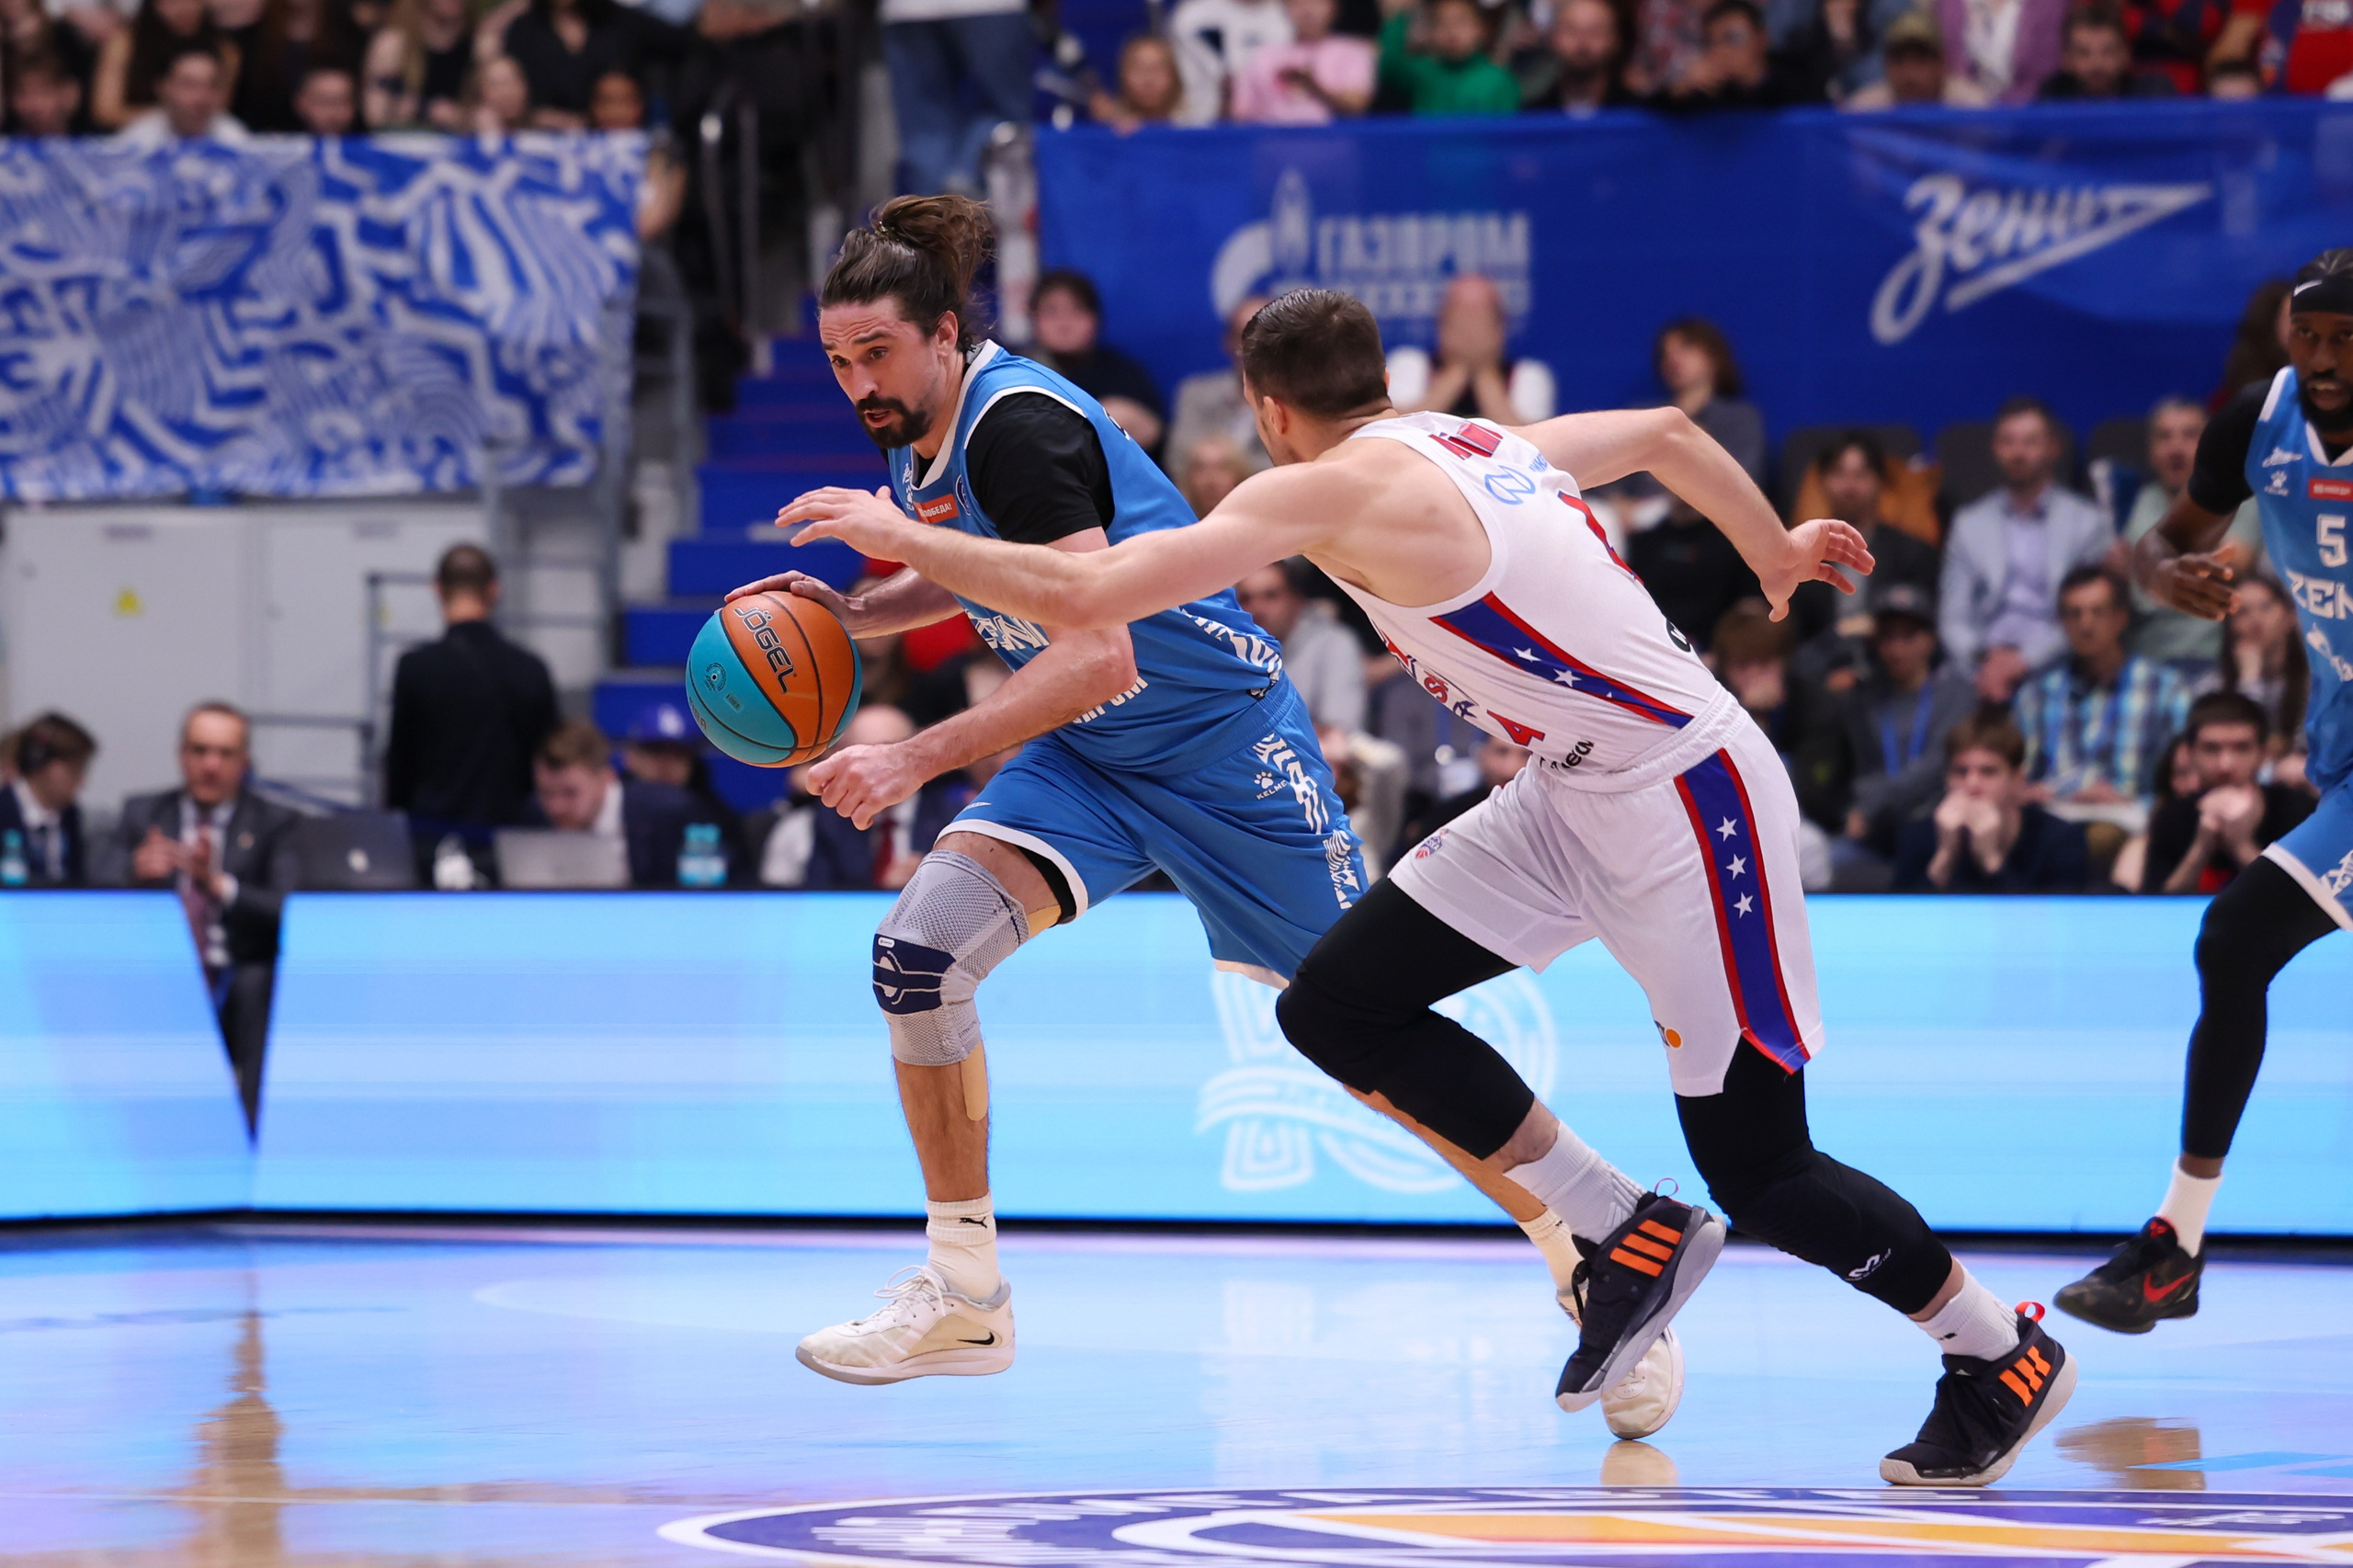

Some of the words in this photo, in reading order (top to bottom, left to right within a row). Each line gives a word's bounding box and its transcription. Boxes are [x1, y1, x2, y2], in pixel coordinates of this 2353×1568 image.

[1315, 214, 1531, 277] ГАЗПРОМ
[2316, 513, 2347, 567] 5
[733, 607, 796, 694] JÖGEL
[1256, 778, 1288, 801] KELME
